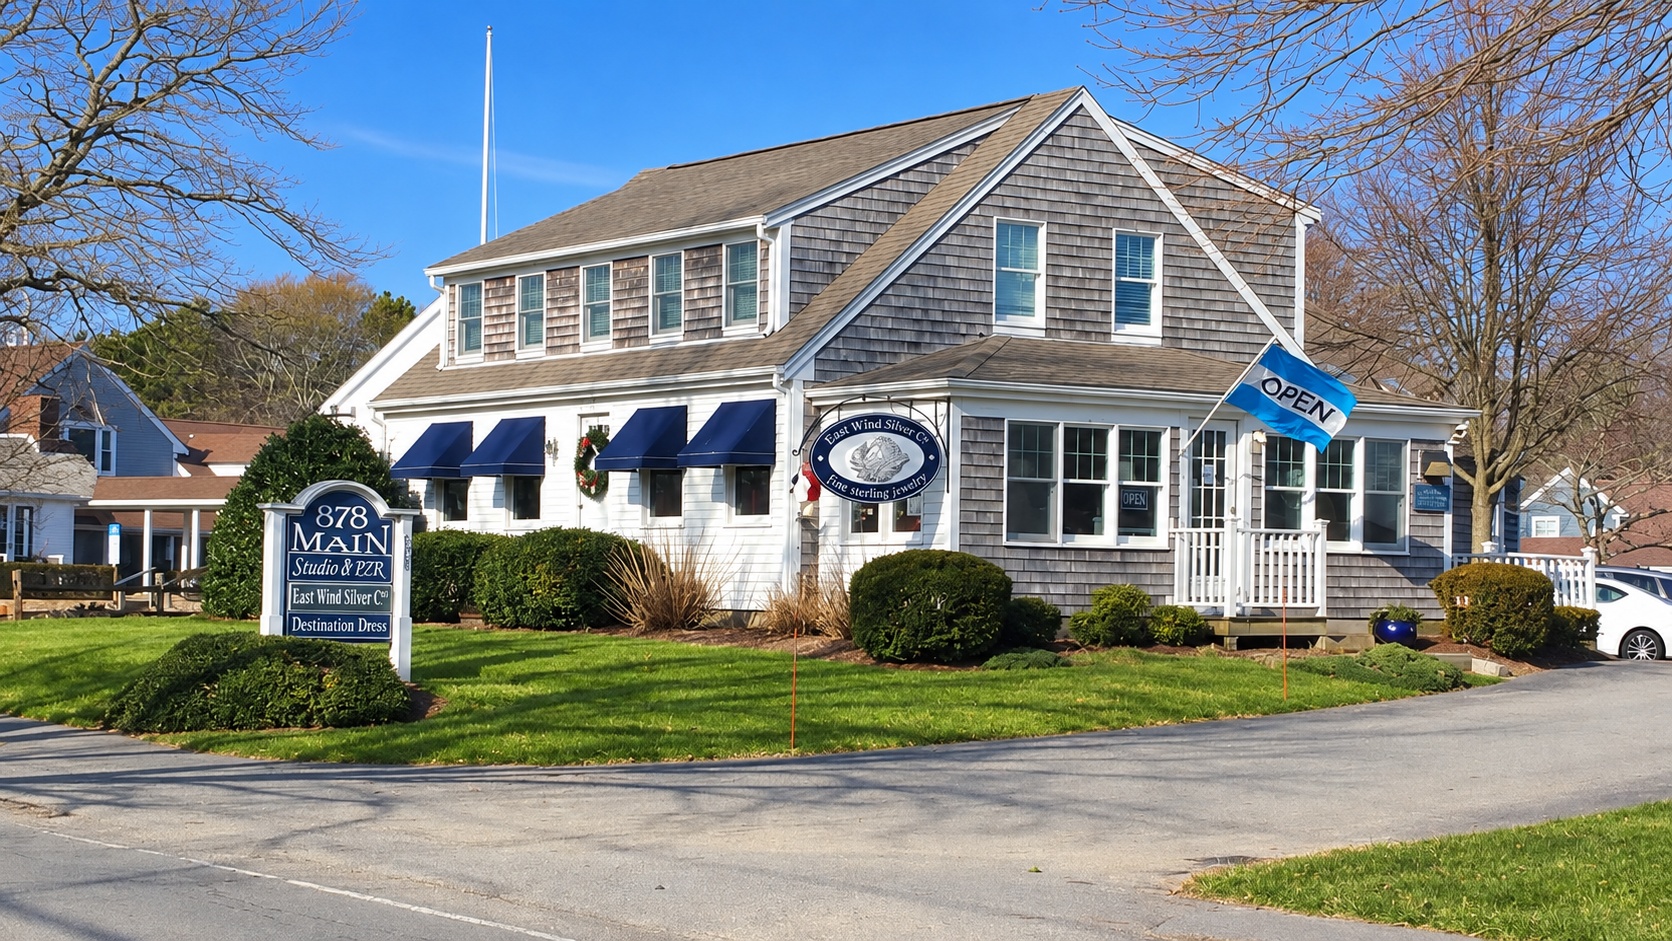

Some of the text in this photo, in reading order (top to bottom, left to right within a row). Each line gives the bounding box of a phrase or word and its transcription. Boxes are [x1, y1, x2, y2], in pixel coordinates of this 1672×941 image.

[1261, 377, 1336, 424] OPEN
[825, 426, 849, 444] East
[851, 418, 882, 431] Wind
[883, 419, 916, 436] Silver
[849, 486, 890, 500] sterling
[893, 473, 926, 498] jewelry
[1123, 492, 1146, 506] OPEN
[316, 505, 368, 529] 878
[291, 522, 390, 555] MAIN
[292, 557, 339, 577] Studio
[340, 558, 354, 577] &
[292, 587, 315, 605] East
[316, 588, 342, 604] Wind
[343, 588, 373, 606] Silver
[292, 616, 387, 632] Destination Dress
